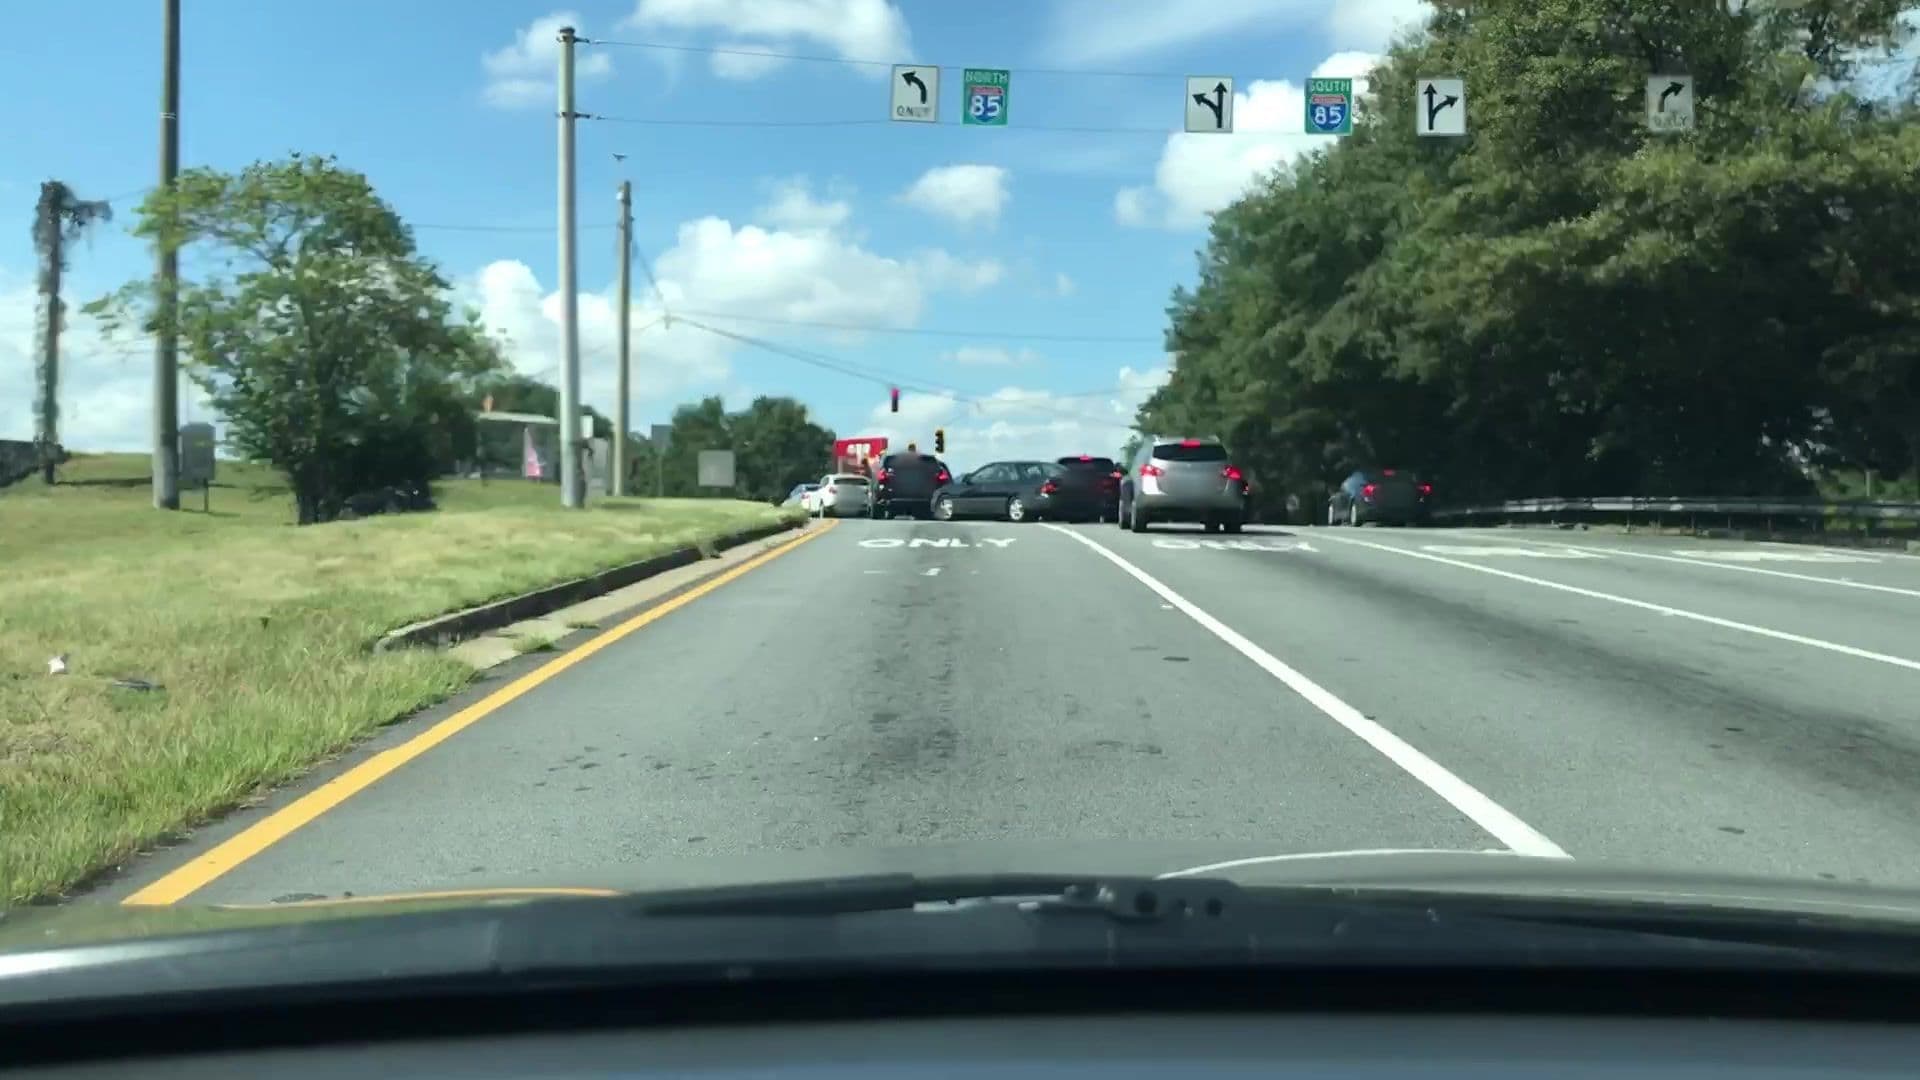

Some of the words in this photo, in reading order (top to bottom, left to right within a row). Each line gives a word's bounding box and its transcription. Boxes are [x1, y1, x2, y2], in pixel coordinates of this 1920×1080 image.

[1309, 79, 1350, 92] SOUTH
[971, 94, 1001, 117] 85
[1314, 106, 1342, 125] 85
[858, 537, 1017, 549] ONLY
